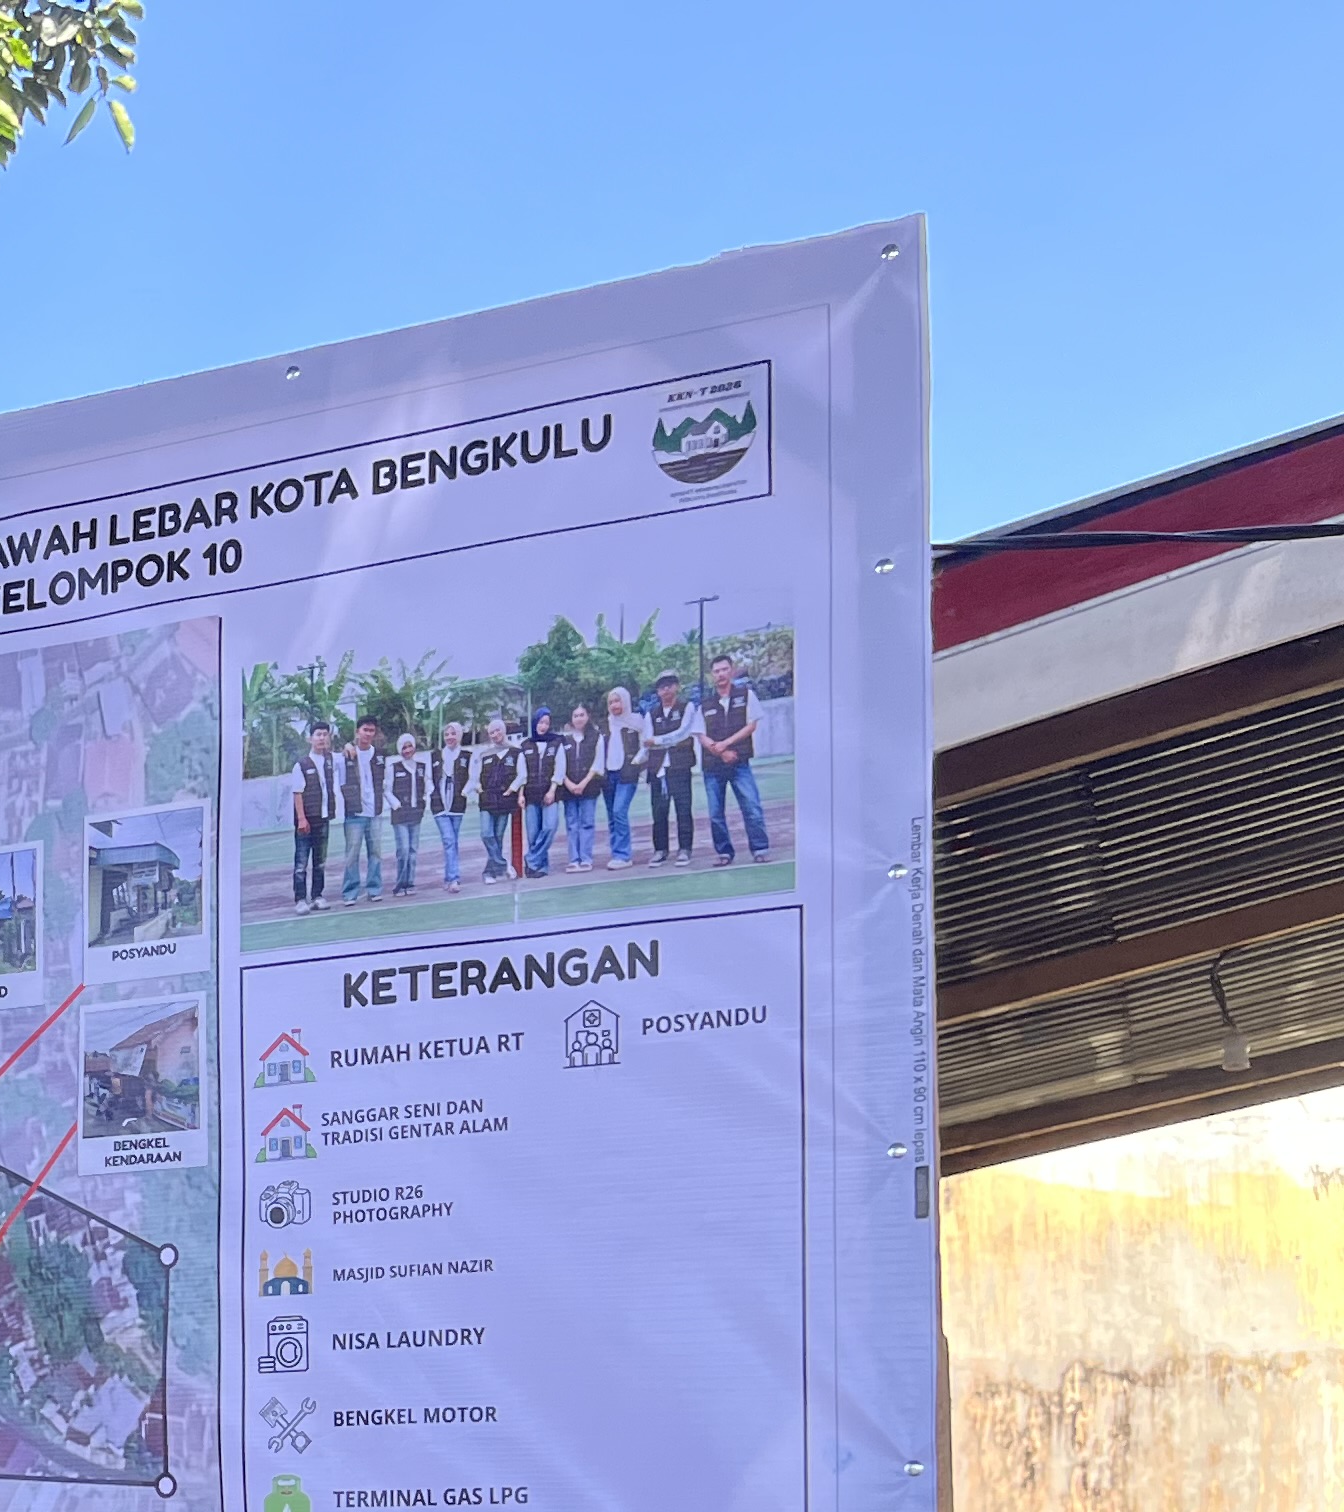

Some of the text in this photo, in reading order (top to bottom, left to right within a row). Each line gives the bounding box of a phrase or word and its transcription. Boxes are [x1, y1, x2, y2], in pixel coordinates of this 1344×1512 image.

[109, 491, 238, 546] LEBAR
[250, 467, 359, 519] KOTA
[371, 413, 613, 496] BENGKULU
[202, 539, 242, 576] 10
[911, 817, 925, 863] Lembar
[909, 867, 924, 899] Kerja
[912, 904, 924, 944] Denah
[112, 943, 176, 961] POSYANDU
[912, 949, 925, 971] dan
[343, 939, 659, 1008] KETERANGAN
[913, 976, 925, 1006] Mata
[642, 1005, 766, 1035] POSYANDU
[910, 1010, 926, 1046] Angin
[331, 1032, 524, 1068] RUMAH KETUA RT
[913, 1050, 926, 1072] 110
[321, 1099, 483, 1127] SANGGAR SENI DAN
[914, 1106, 924, 1124] cm
[321, 1117, 508, 1146] TRADISI GENTAR ALAM
[912, 1128, 926, 1162] lepas
[105, 1151, 182, 1167] KENDARAAN
[332, 1185, 423, 1206] STUDIO R26
[333, 1202, 453, 1225] PHOTOGRAPHY
[333, 1259, 493, 1283] MASJID SUFIAN NAZIR
[333, 1327, 485, 1350] NISA LAUNDRY
[334, 1406, 497, 1427] BENGKEL MOTOR
[333, 1487, 528, 1508] TERMINAL GAS LPG
